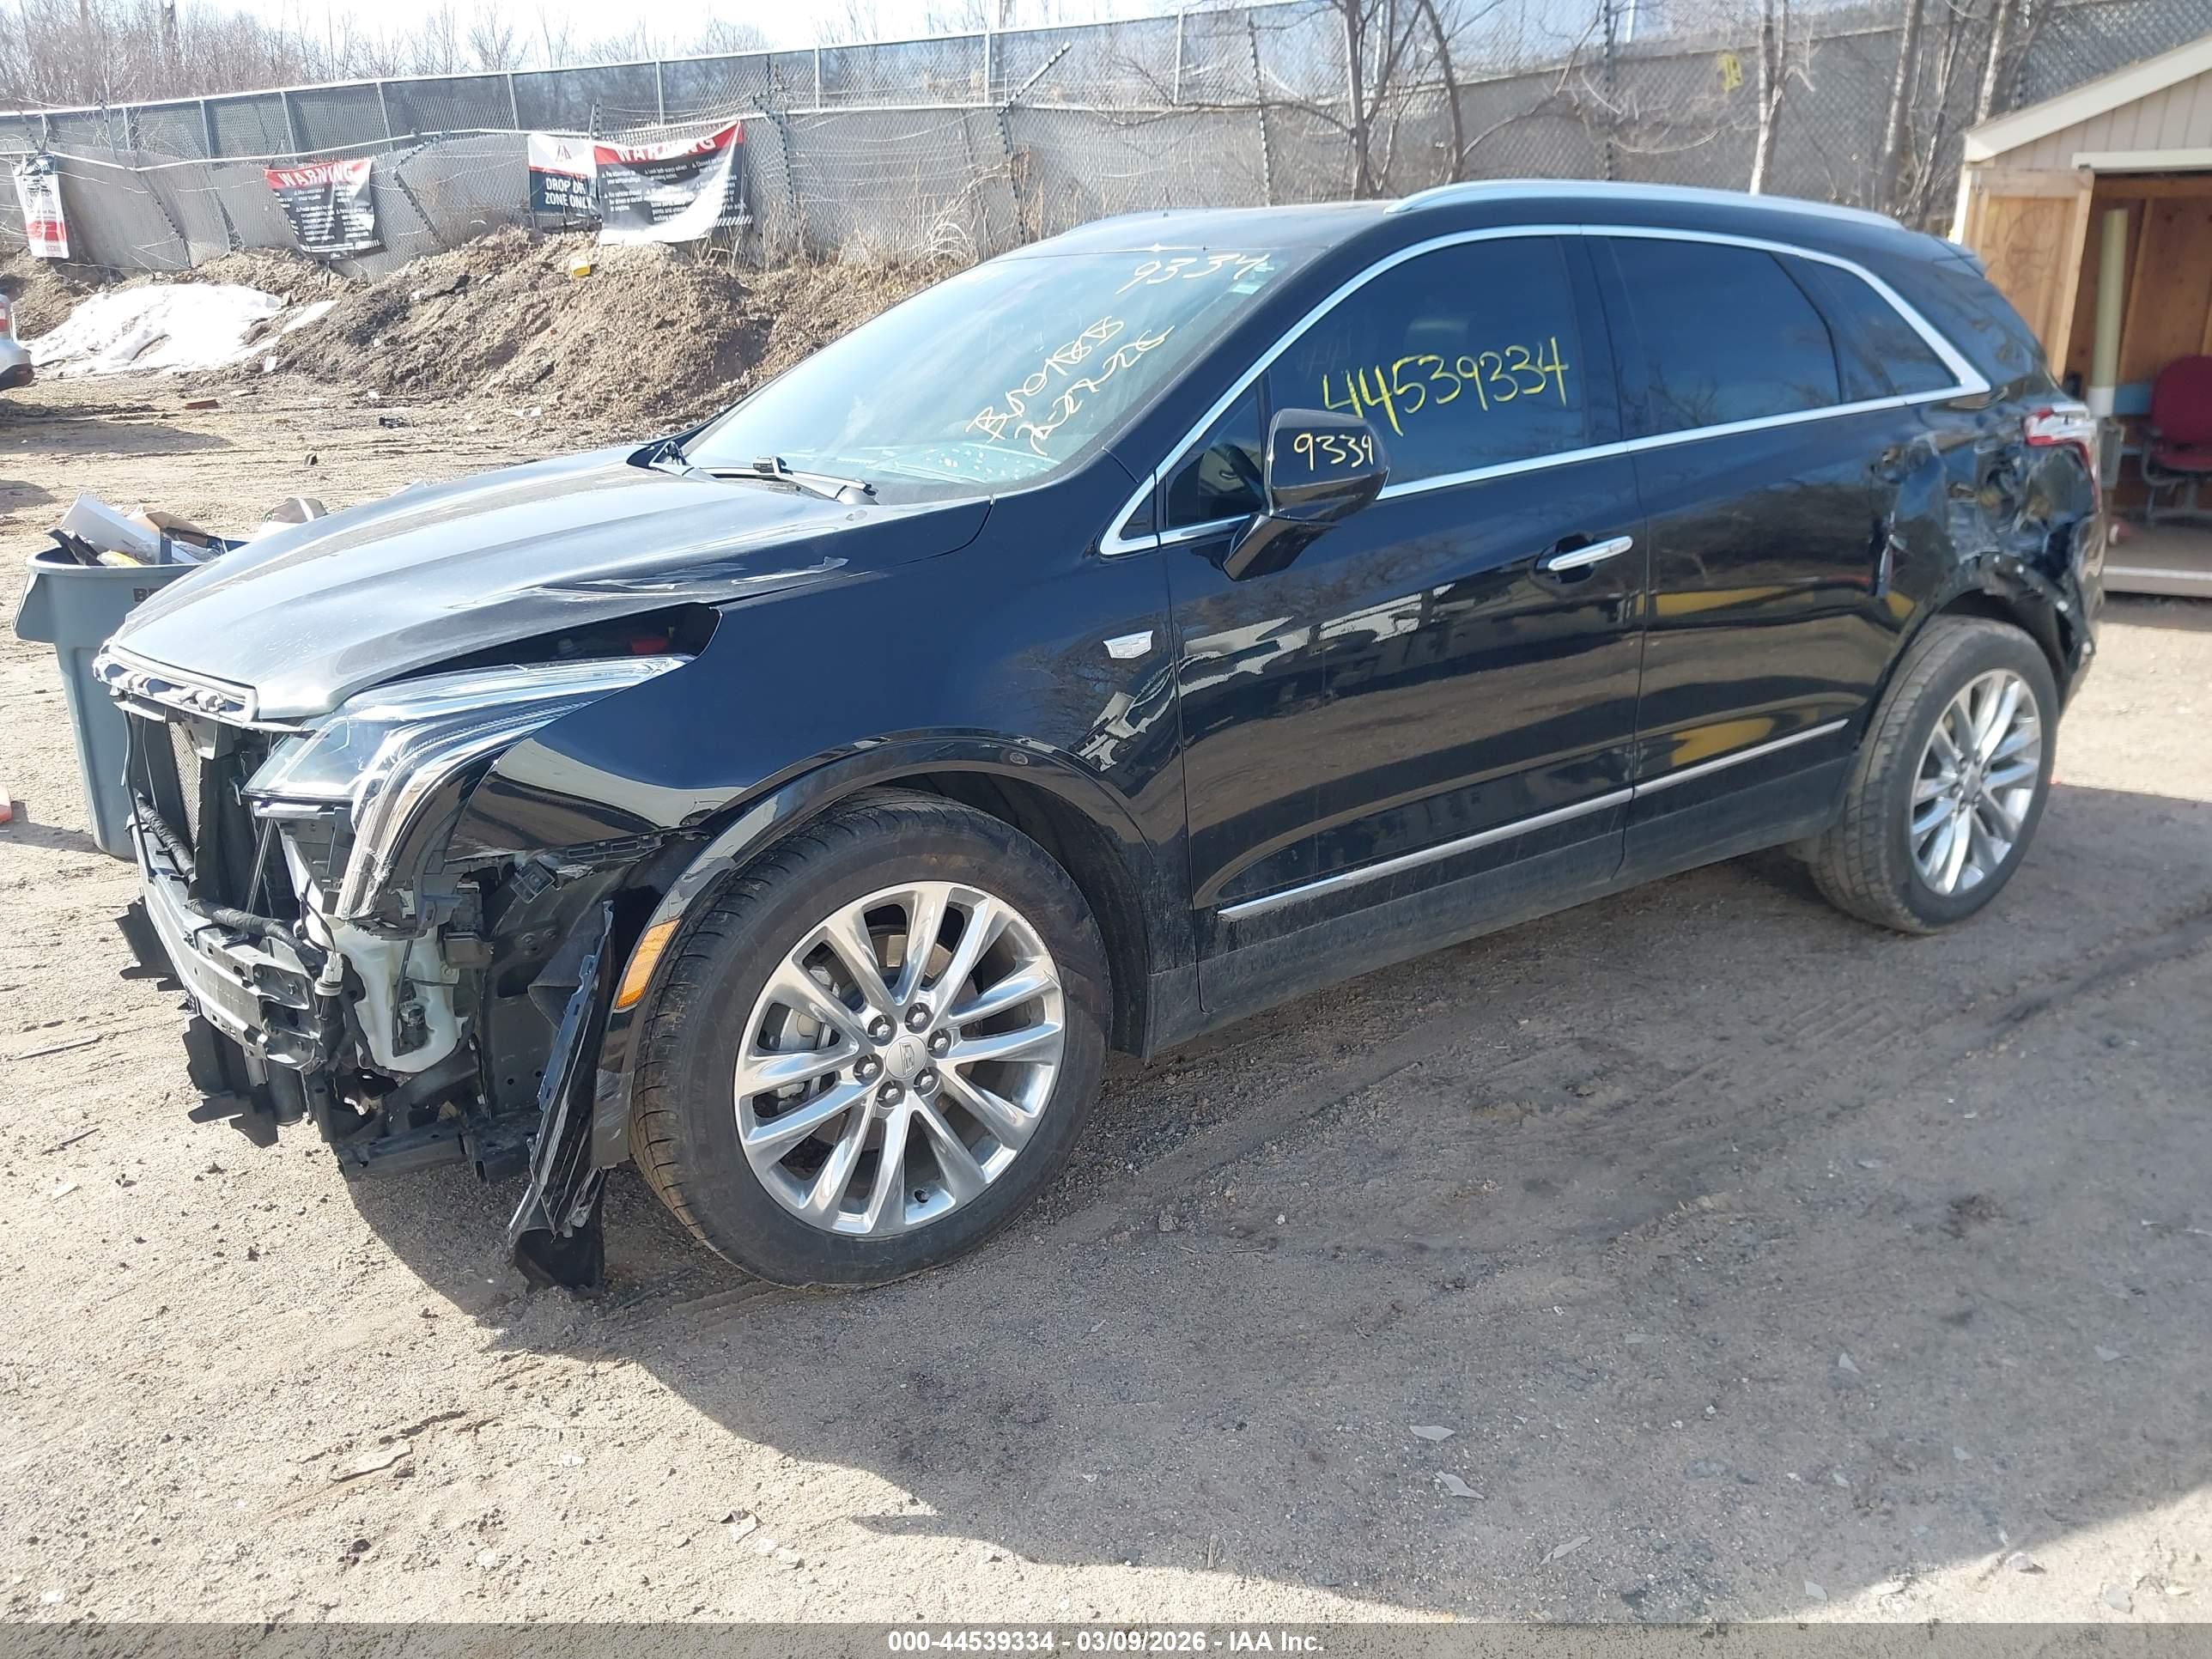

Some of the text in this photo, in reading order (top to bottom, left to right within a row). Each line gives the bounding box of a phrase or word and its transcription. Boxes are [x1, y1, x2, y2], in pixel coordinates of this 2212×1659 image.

[615, 137, 716, 163] WARNNG
[277, 163, 354, 187] WARNING
[545, 177, 571, 192] DROP
[544, 191, 592, 210] ZONE ONLY
[1116, 252, 1271, 295] 9334
[1322, 336, 1570, 437] 44539334
